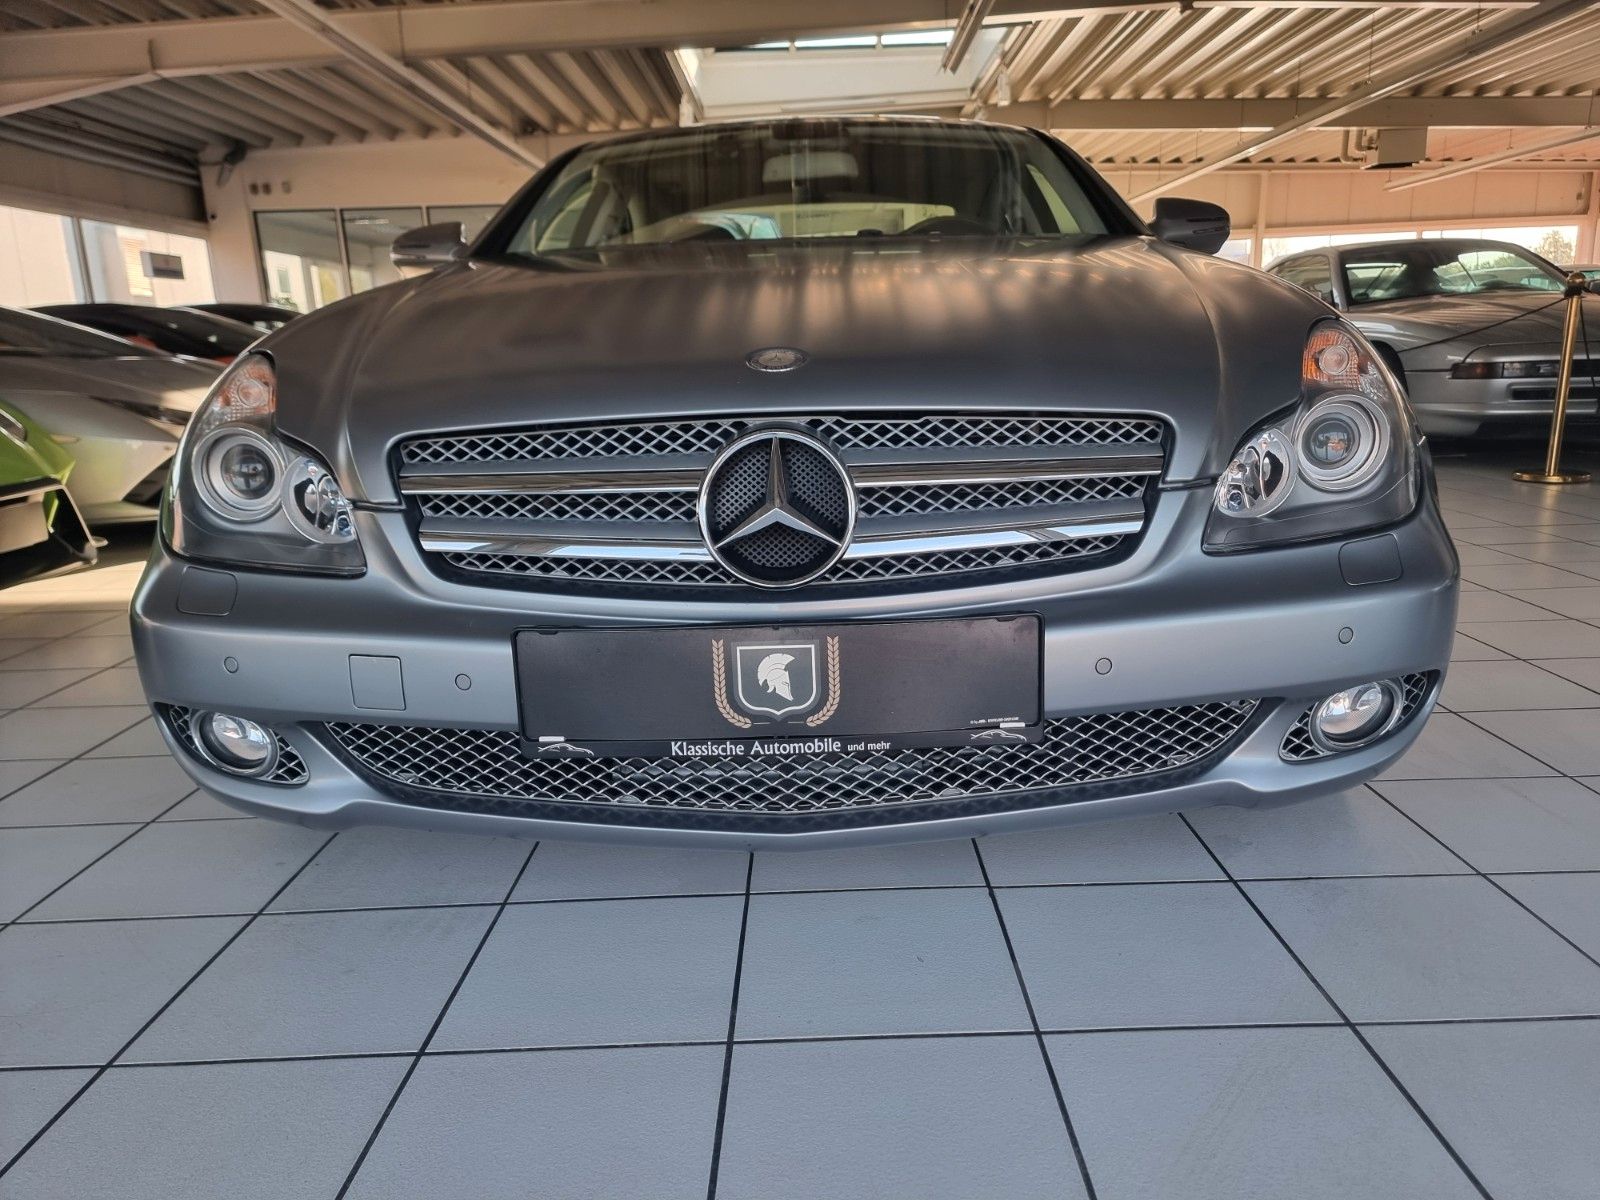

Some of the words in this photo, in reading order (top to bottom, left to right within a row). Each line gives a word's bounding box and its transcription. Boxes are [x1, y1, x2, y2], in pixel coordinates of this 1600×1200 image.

[671, 741, 745, 756] Klassische
[750, 738, 841, 755] Automobile
[847, 741, 865, 752] und
[867, 740, 891, 751] mehr
